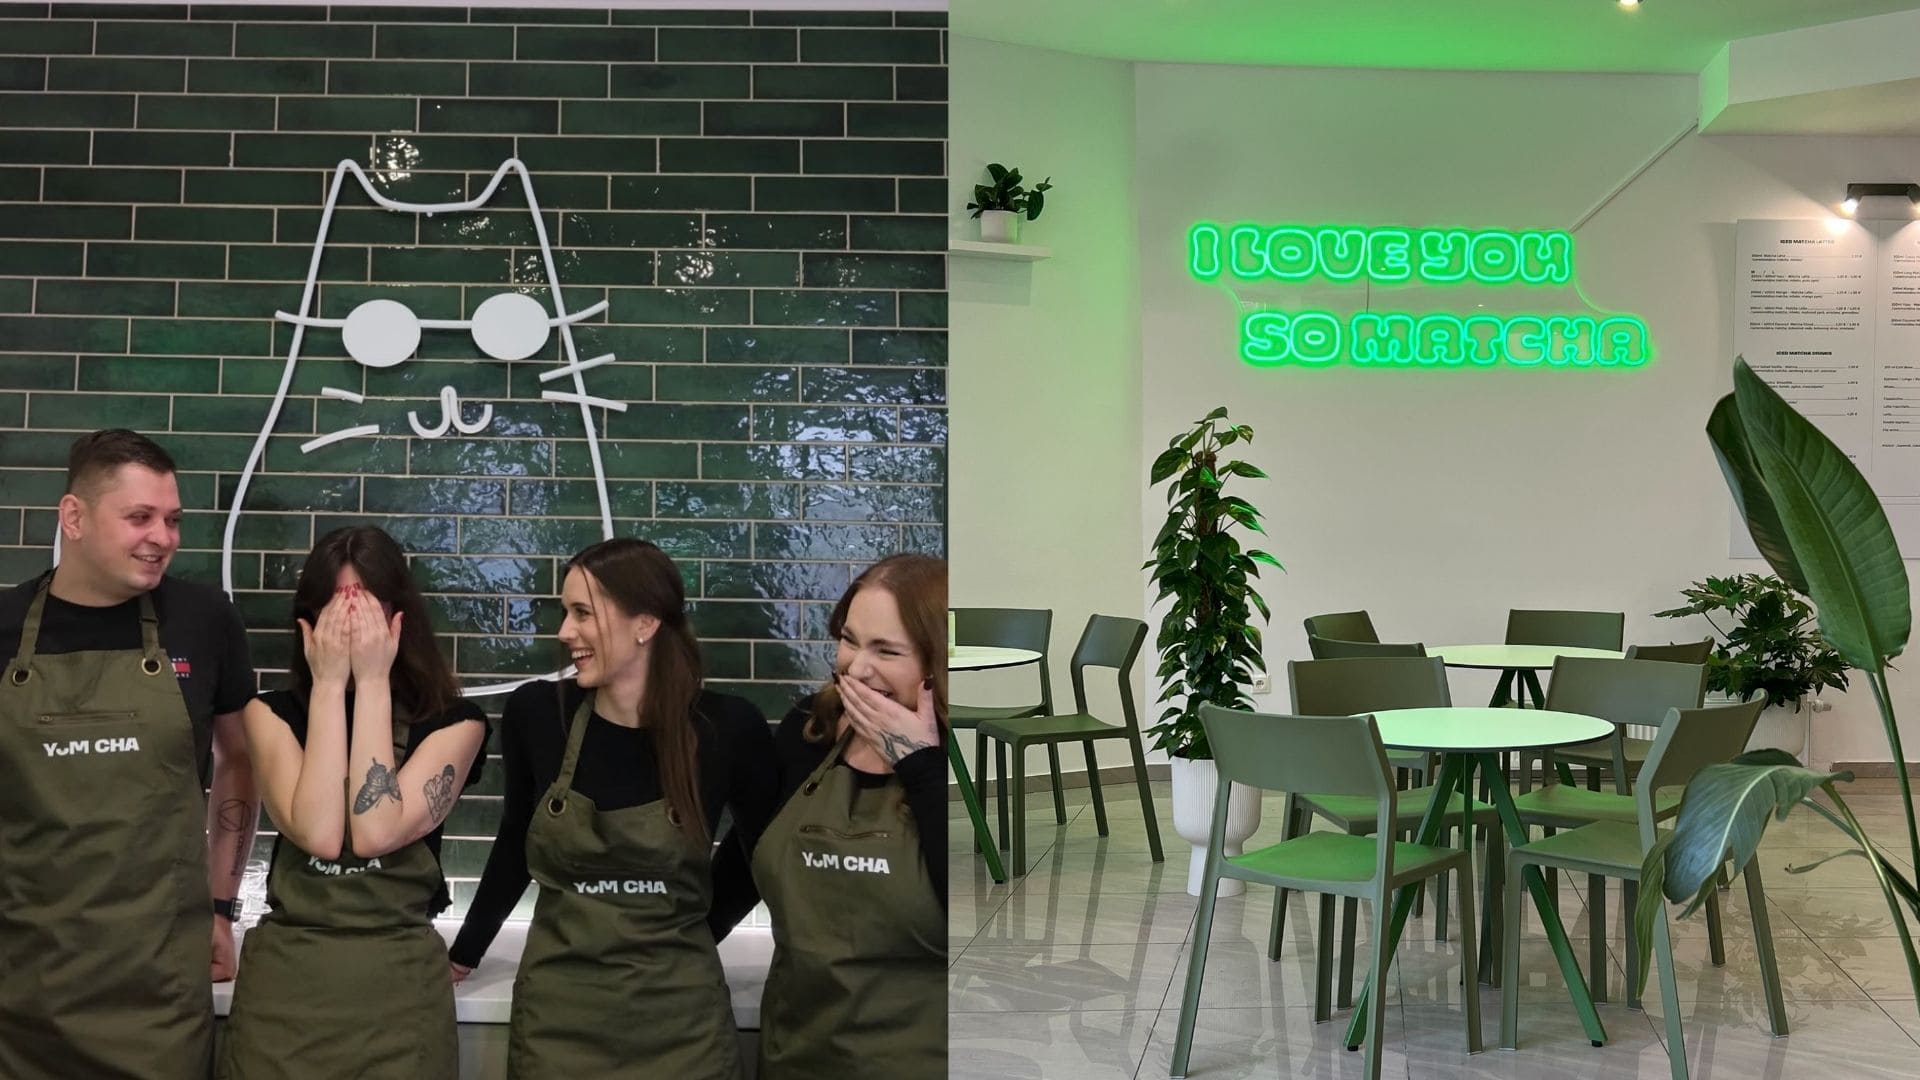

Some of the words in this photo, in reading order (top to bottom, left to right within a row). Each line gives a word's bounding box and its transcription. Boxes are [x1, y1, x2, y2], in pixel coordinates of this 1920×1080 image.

[1191, 224, 1221, 278] I
[1229, 225, 1412, 283] LOVE
[1418, 229, 1571, 284] YOU
[1243, 311, 1342, 364] SO
[1349, 312, 1650, 367] MATCHA
[94, 737, 140, 753] CHA
[843, 855, 890, 874] CHA
[623, 880, 667, 895] CHA
